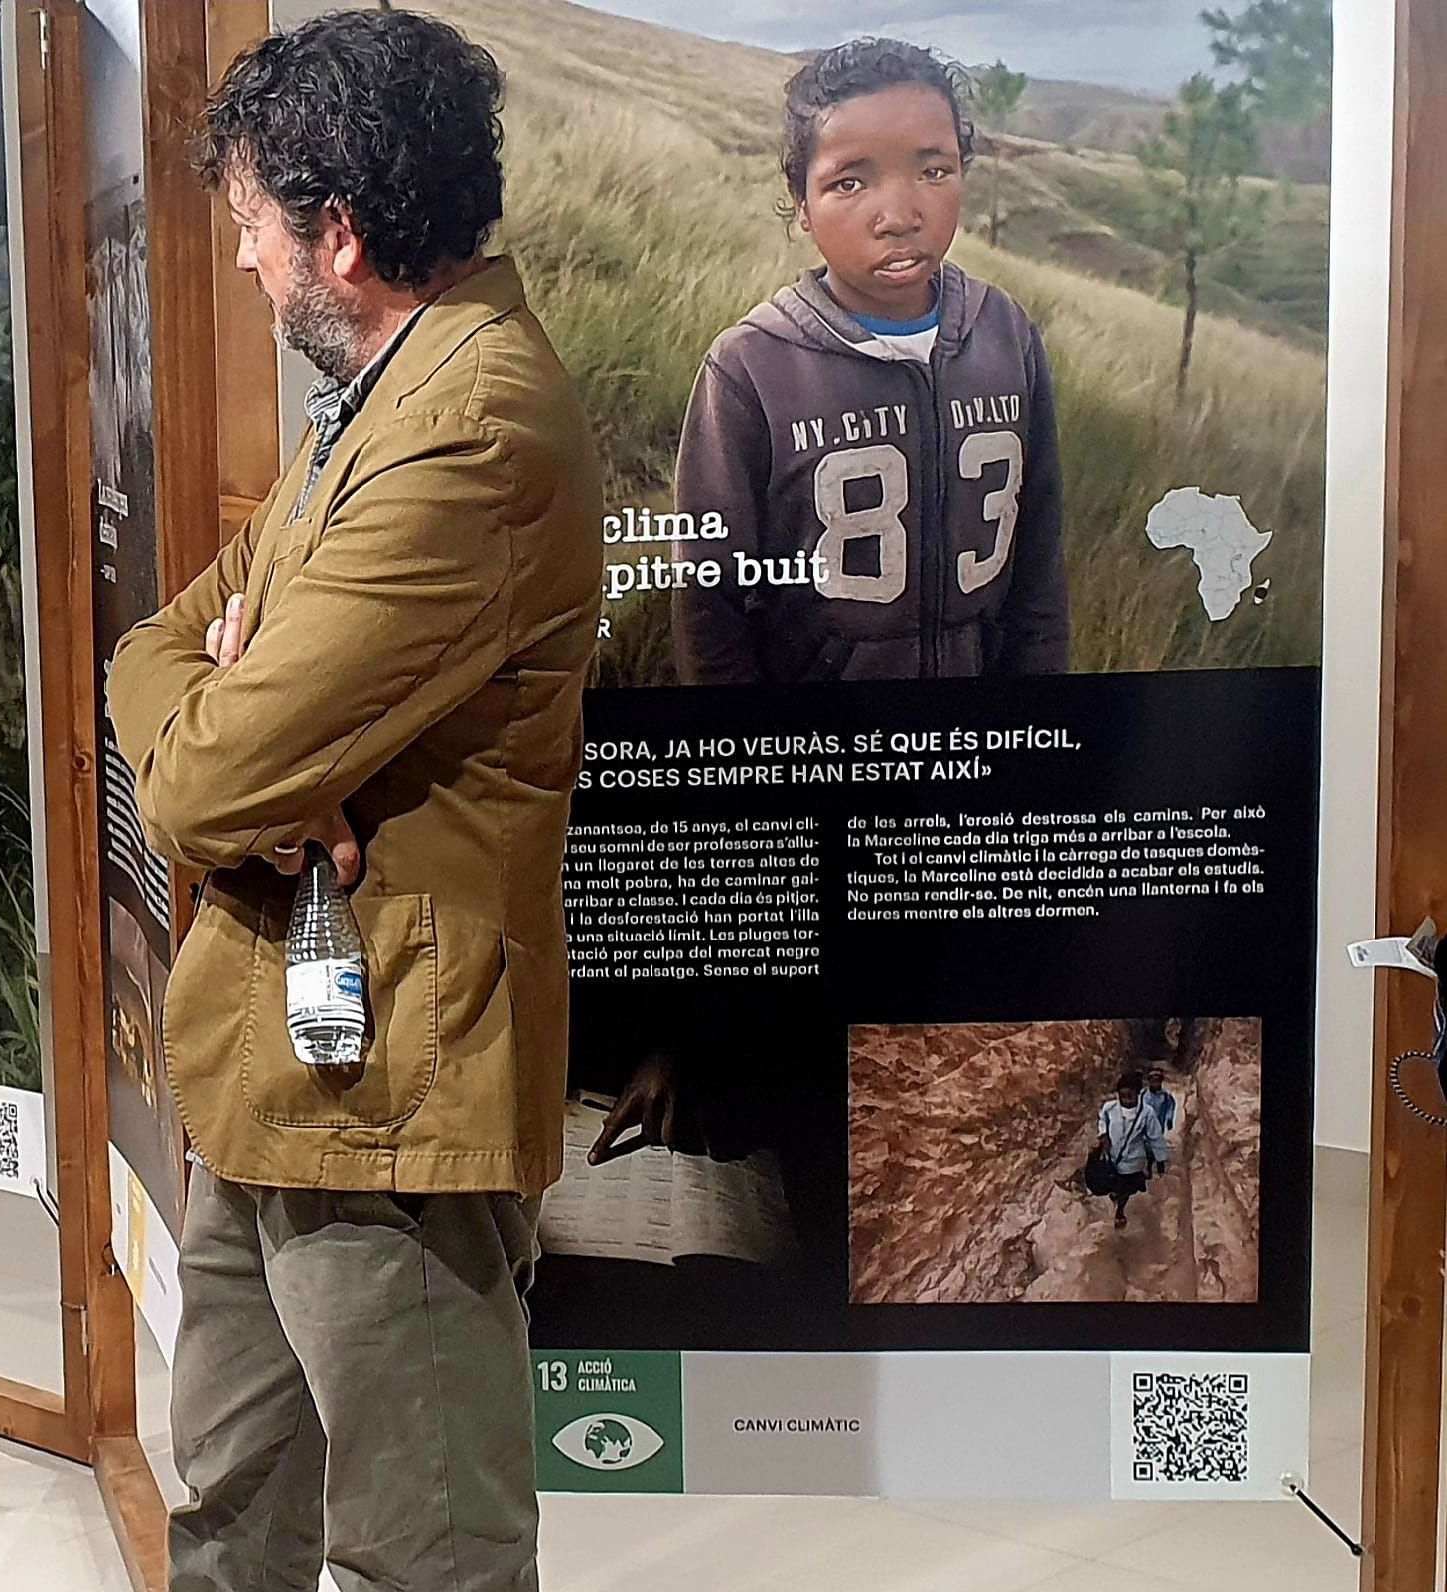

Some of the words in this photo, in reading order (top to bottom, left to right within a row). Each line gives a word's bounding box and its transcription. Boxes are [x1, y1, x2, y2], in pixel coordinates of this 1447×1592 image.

[602, 507, 729, 544] clima
[814, 443, 908, 603] 8
[957, 430, 1023, 594] 3
[603, 554, 722, 600] pitre
[732, 550, 830, 586] buit
[597, 618, 612, 638] R
[585, 741, 656, 761] SORA,
[665, 740, 691, 758] JA
[700, 738, 735, 757] HO
[743, 732, 845, 756] VEURÀS.
[854, 731, 883, 752] SÉ
[891, 732, 941, 753] QUE
[950, 729, 978, 750] ÉS
[987, 727, 1081, 750] DIFÍCIL,
[577, 769, 593, 789] S
[600, 769, 679, 788] COSES
[688, 765, 784, 785] SEMPRE
[792, 764, 842, 783] HAN
[852, 762, 924, 781] ESTAT
[931, 757, 991, 780] AIXÍ»
[847, 815, 867, 829] de
[874, 815, 897, 829] les
[903, 813, 951, 829] arrels,
[959, 811, 1015, 827] l'erosió
[1021, 811, 1097, 826] destrossa
[1103, 808, 1126, 824] els
[1133, 807, 1194, 823] camins.
[1201, 806, 1227, 820] Per
[1233, 804, 1266, 820] això
[847, 833, 861, 848] la
[864, 832, 941, 847] Marceline
[943, 831, 982, 846] cada
[984, 830, 1009, 845] dia
[1012, 830, 1050, 847] triga
[1053, 828, 1086, 844] més
[1088, 831, 1098, 843] a
[1101, 827, 1154, 842] arribar
[1156, 829, 1166, 840] a
[1170, 824, 1231, 840] l'escola.
[873, 852, 898, 866] Tot
[901, 852, 906, 865] i
[908, 850, 923, 865] el
[925, 849, 966, 865] canvi
[969, 848, 1032, 864] climàtic
[1034, 849, 1039, 863] i
[1042, 847, 1056, 863] la
[1058, 847, 1118, 864] càrrega
[1120, 845, 1141, 860] de
[1143, 846, 1205, 861] tasques
[1206, 842, 1265, 857] domès-
[847, 870, 899, 887] tiques,
[904, 869, 917, 883] la
[921, 868, 997, 883] Marceline
[1000, 867, 1034, 882] està
[1037, 865, 1105, 881] decidida
[1107, 868, 1118, 879] a
[1120, 863, 1175, 879] acabar
[1177, 862, 1200, 877] els
[1203, 860, 1265, 876] estudis.
[564, 894, 614, 908] arribar
[616, 897, 626, 907] a
[628, 893, 679, 907] classe.
[682, 894, 686, 906] I
[689, 891, 726, 906] cada
[729, 891, 753, 905] dia
[755, 891, 773, 905] és
[776, 890, 819, 907] pitjor.
[847, 889, 869, 903] No
[873, 891, 920, 905] pensa
[924, 887, 998, 901] rendir-se.
[1002, 886, 1024, 900] De
[1027, 885, 1053, 901] nit,
[1057, 883, 1105, 899] encén
[1108, 886, 1137, 897] una
[1141, 881, 1210, 897] llanterna
[1214, 880, 1219, 894] i
[1223, 879, 1238, 894] fa
[1241, 879, 1265, 894] els
[570, 913, 574, 926] i
[579, 911, 593, 926] la
[597, 910, 699, 926] desforestació
[704, 910, 733, 924] han
[738, 910, 785, 926] portat
[790, 908, 820, 922] l'illa
[847, 907, 901, 921] deures
[904, 907, 959, 920] mentre
[962, 904, 985, 919] els
[987, 904, 1032, 919] altres
[1035, 903, 1100, 918] dormen.
[537, 1360, 568, 1393] 13
[577, 1358, 612, 1375] ACCIÓ
[577, 1376, 637, 1393] CLIMÀTICA
[733, 1418, 783, 1433] CANVI
[787, 1416, 861, 1433] CLIMÀTIC
